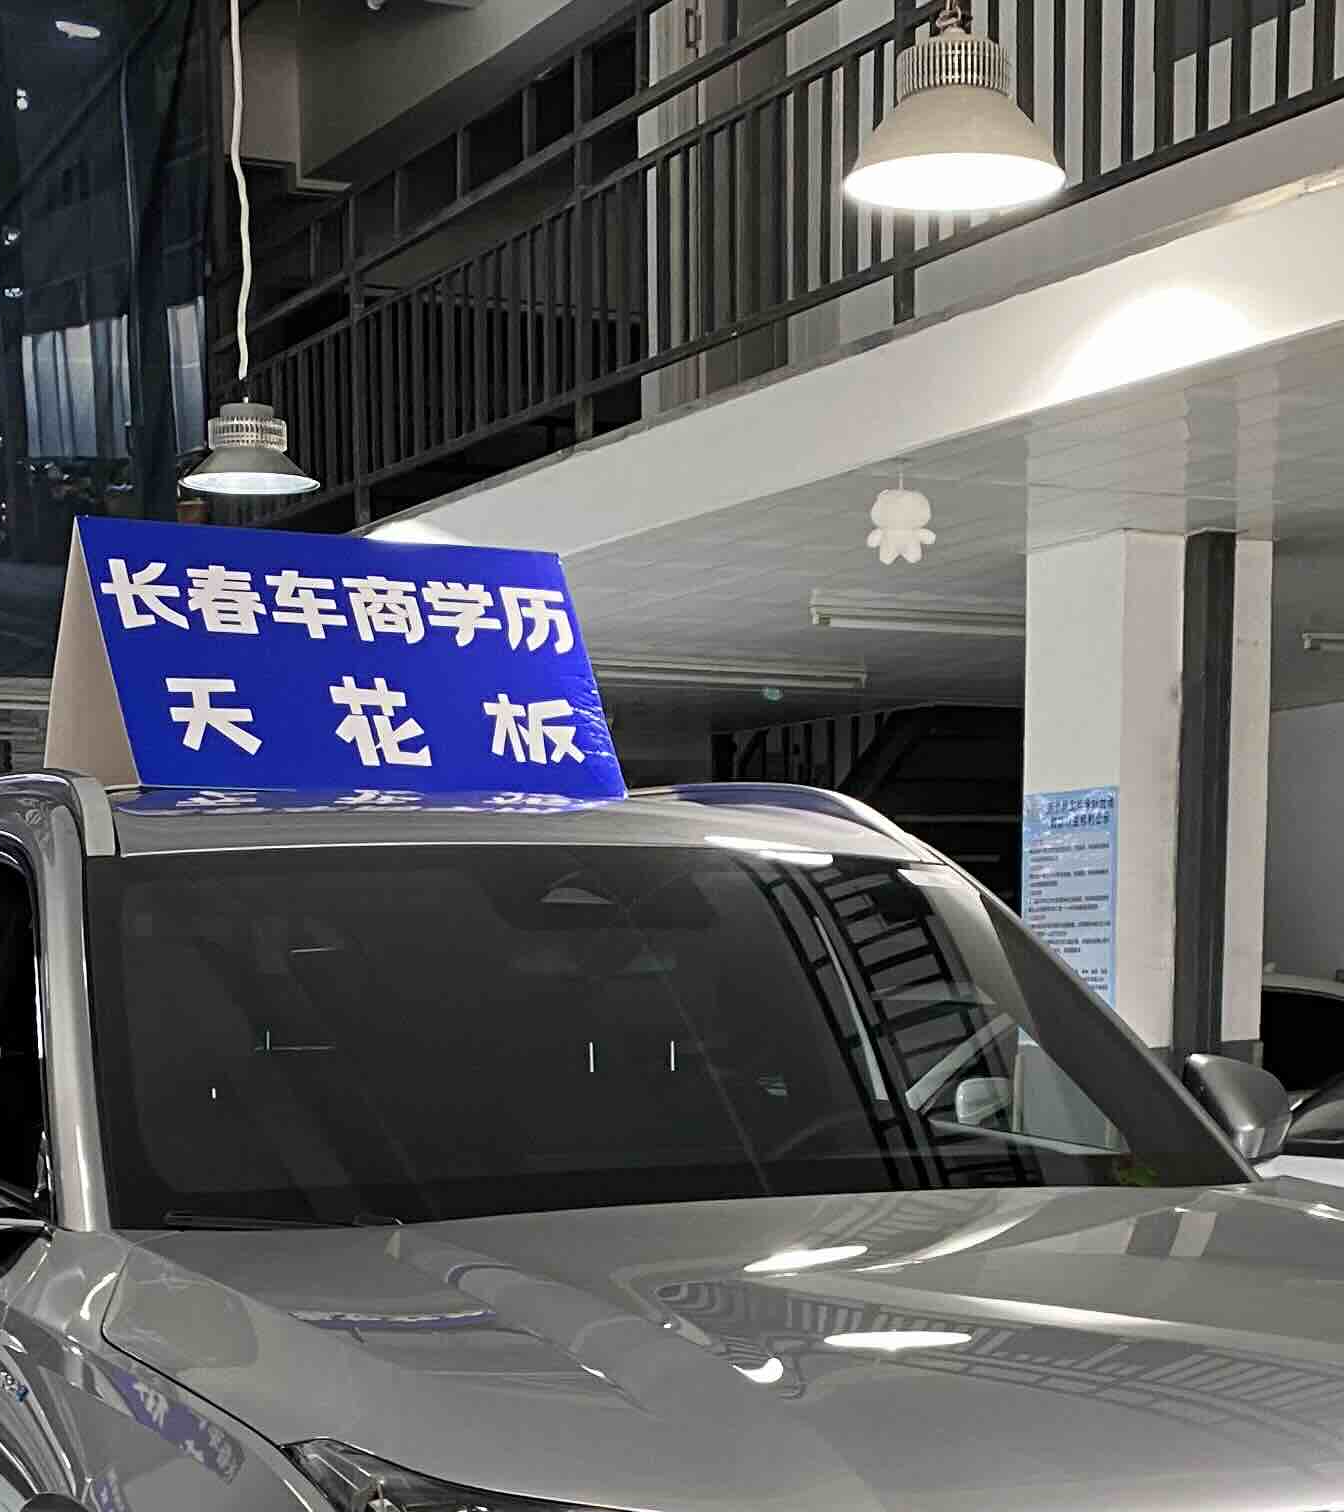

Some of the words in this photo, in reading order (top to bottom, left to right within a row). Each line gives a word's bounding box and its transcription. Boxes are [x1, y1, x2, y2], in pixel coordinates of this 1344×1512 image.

[101, 558, 575, 656] 长春车商学历
[165, 675, 586, 767] 天花板
